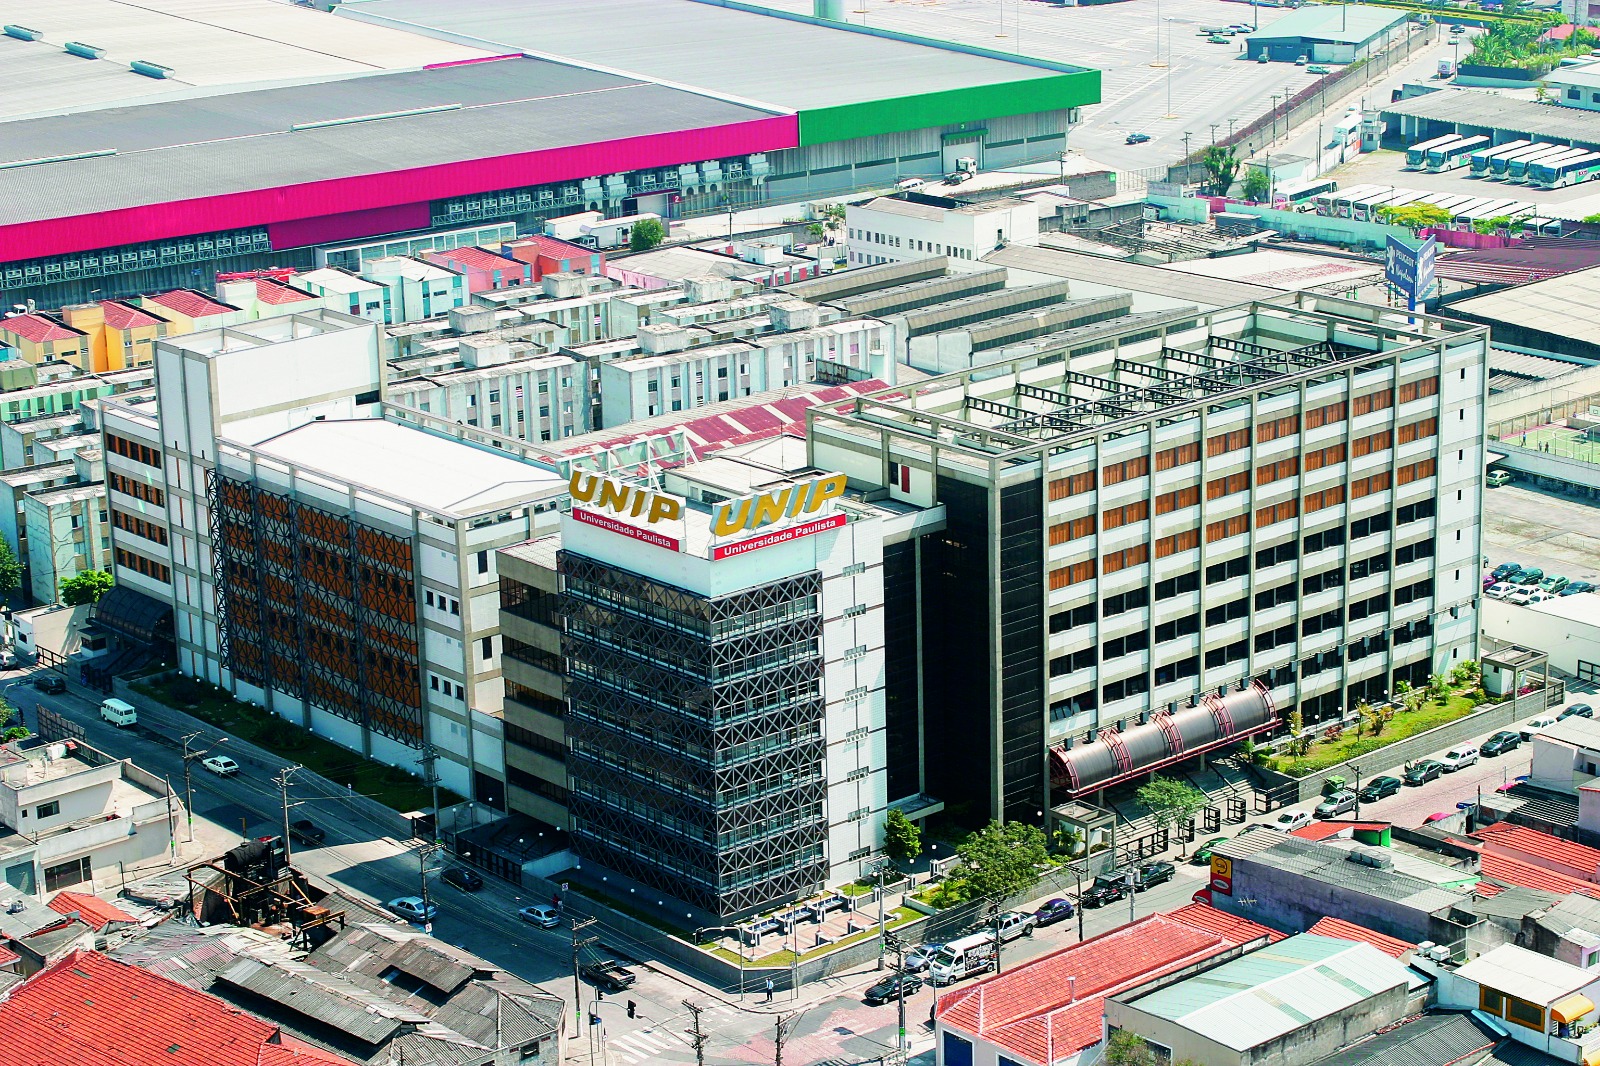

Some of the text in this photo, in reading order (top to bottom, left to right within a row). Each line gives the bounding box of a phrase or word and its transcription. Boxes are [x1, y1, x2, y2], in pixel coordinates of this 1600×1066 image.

[569, 470, 680, 524] UNIP
[714, 474, 847, 537] UNIP
[580, 511, 671, 547] Universidade Paulista
[724, 519, 836, 556] Universidade Paulista
